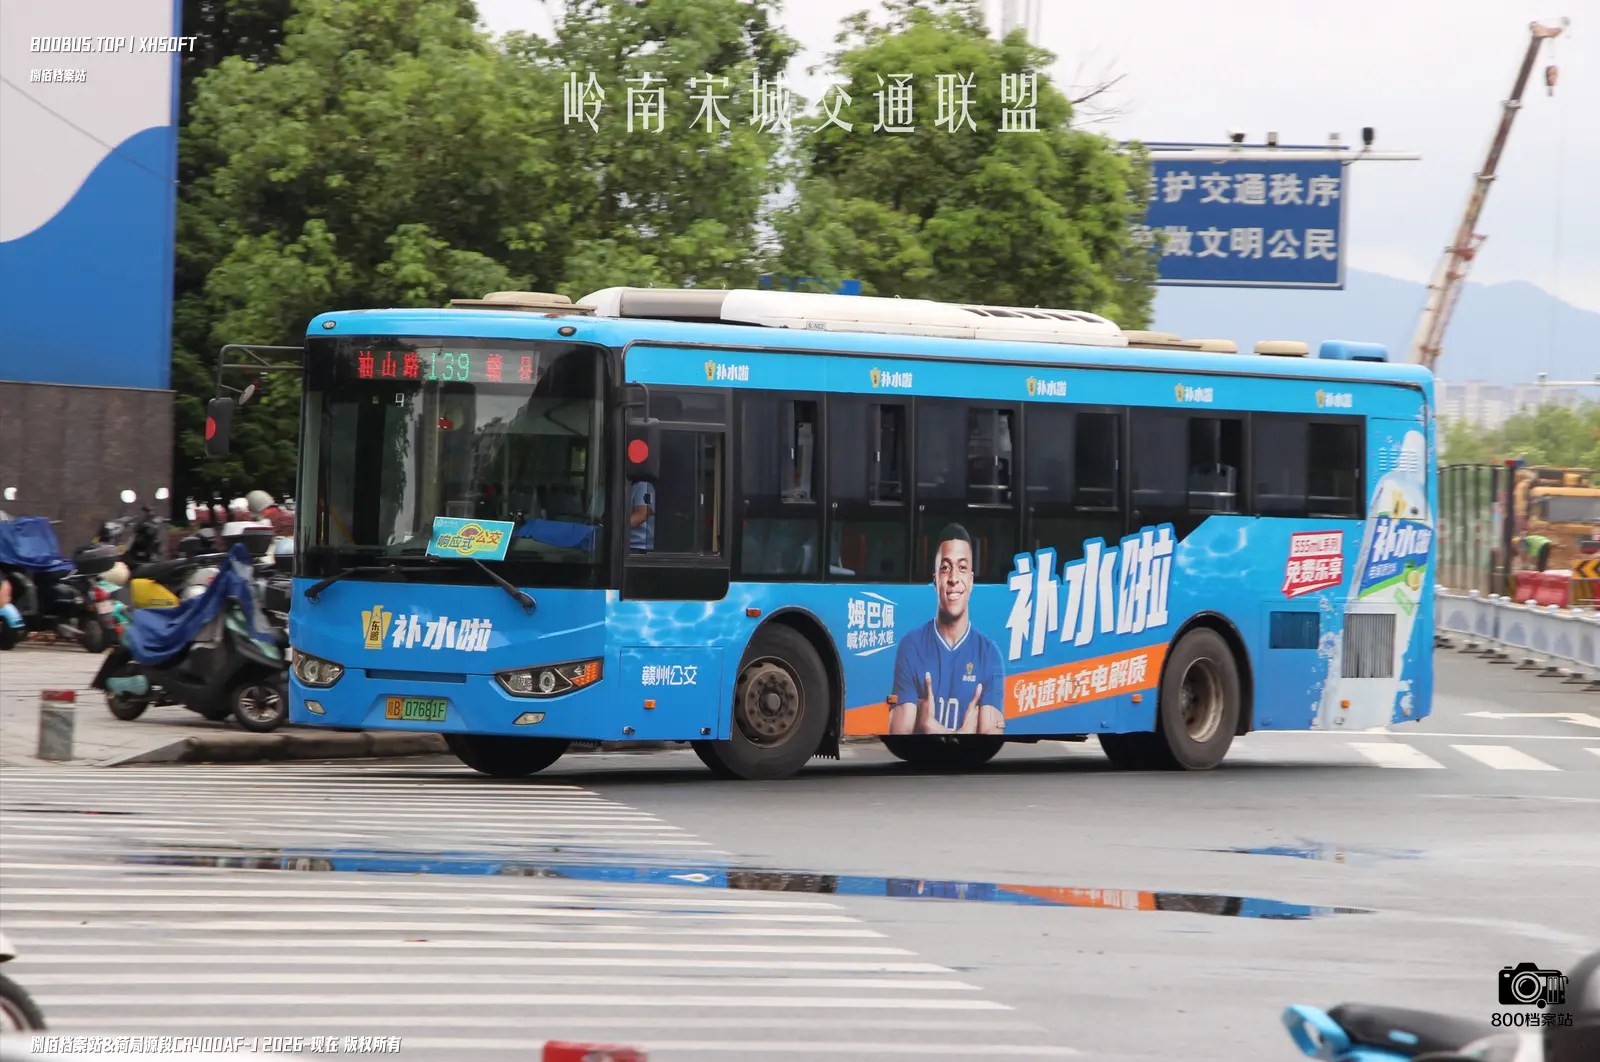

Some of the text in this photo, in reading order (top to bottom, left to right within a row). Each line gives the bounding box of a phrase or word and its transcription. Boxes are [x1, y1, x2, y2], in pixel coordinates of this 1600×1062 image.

[427, 352, 471, 382] 139
[716, 363, 750, 381] 补水啦
[1285, 557, 1343, 587] 免费乐享
[1005, 528, 1174, 661] 补水啦
[847, 598, 895, 629] 姆巴佩
[392, 614, 493, 652] 补水啦
[641, 665, 698, 686] 赣州公交
[1017, 654, 1148, 712] 快速补充电解质
[938, 697, 959, 731] 10
